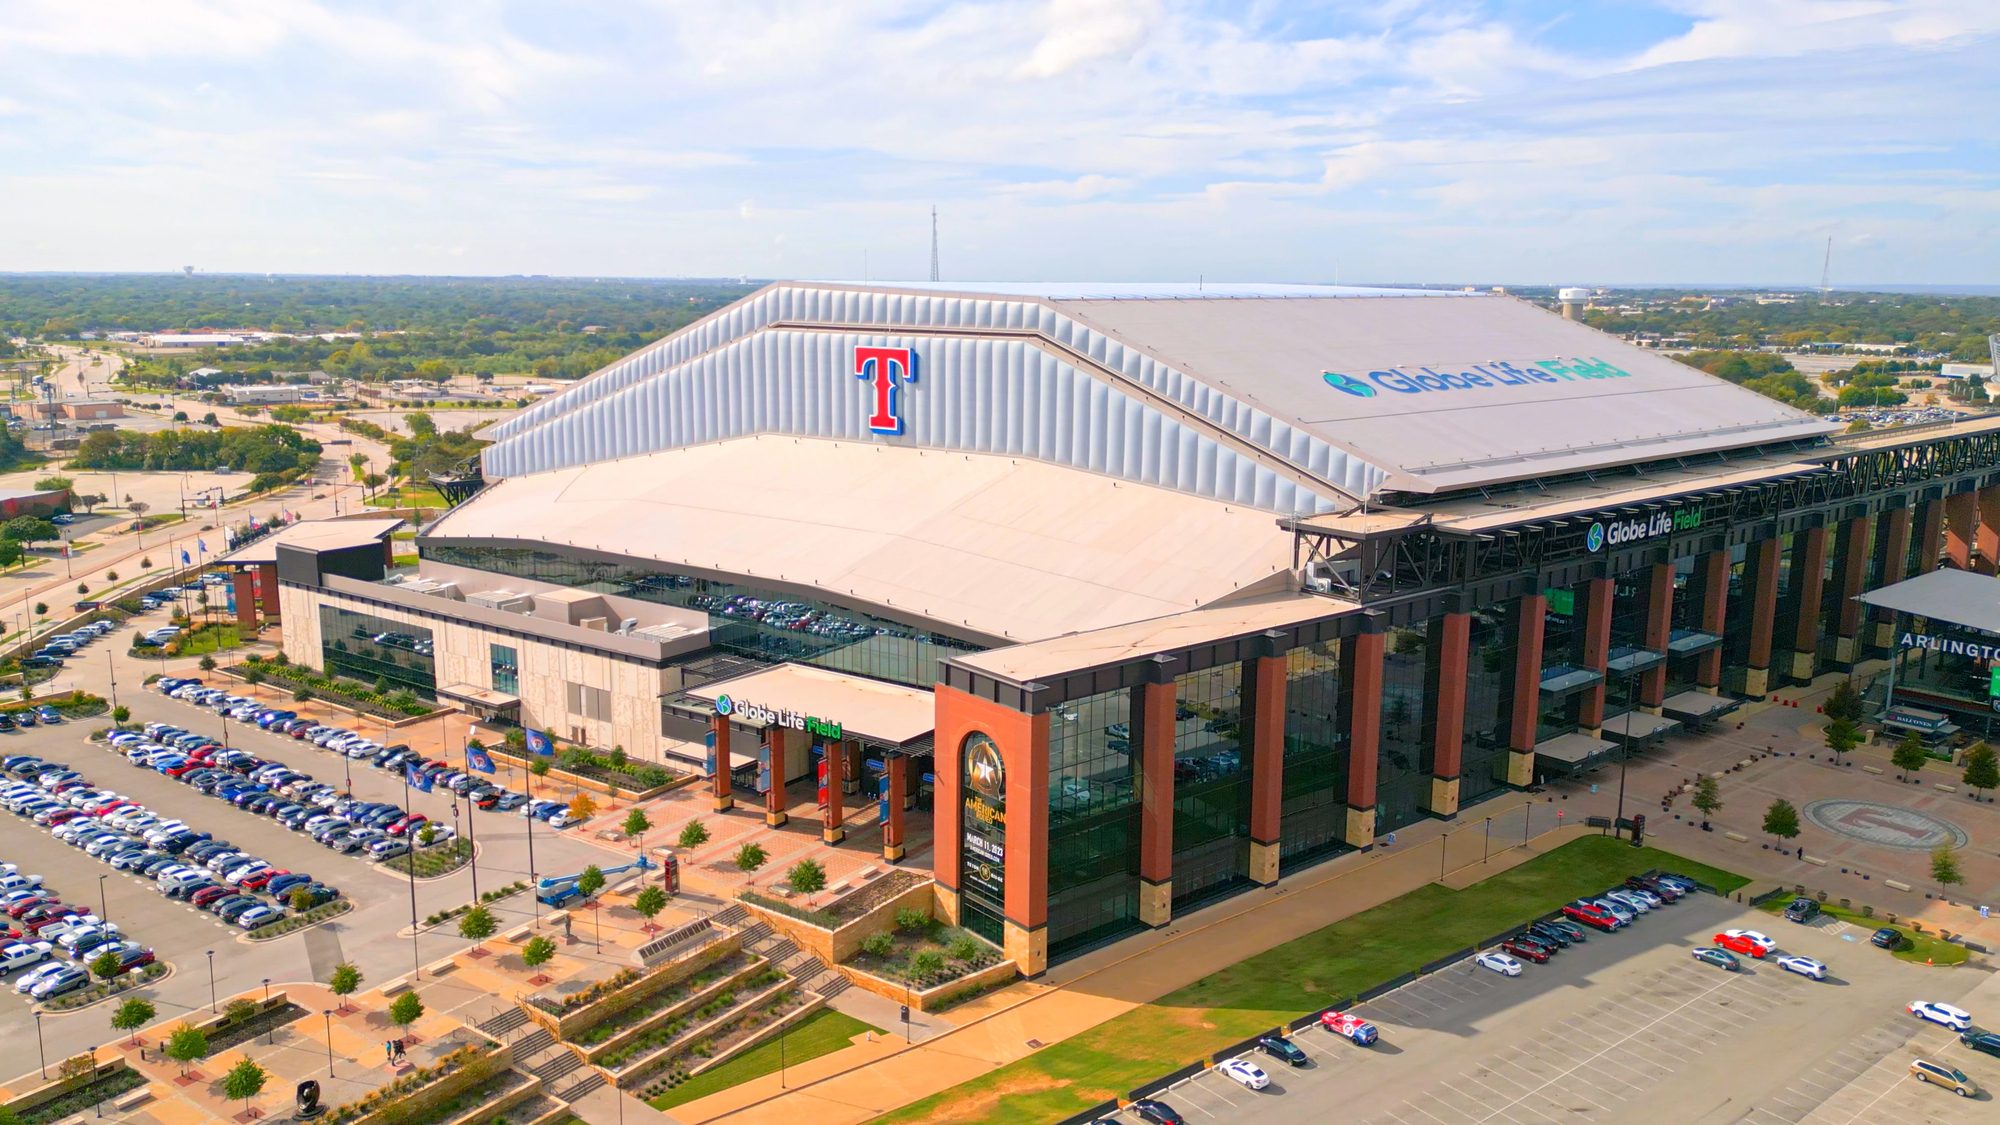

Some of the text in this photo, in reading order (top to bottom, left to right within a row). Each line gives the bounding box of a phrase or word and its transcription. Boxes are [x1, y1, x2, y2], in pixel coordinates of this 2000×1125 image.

[854, 345, 916, 436] T
[1369, 356, 1632, 394] Globe Life Field
[1607, 505, 1702, 545] Globe Life Field
[734, 699, 842, 740] Globe Life Field
[1896, 716, 1932, 728] BALCONES
[965, 797, 1006, 824] AMERICAN
[966, 832, 984, 848] MARCH
